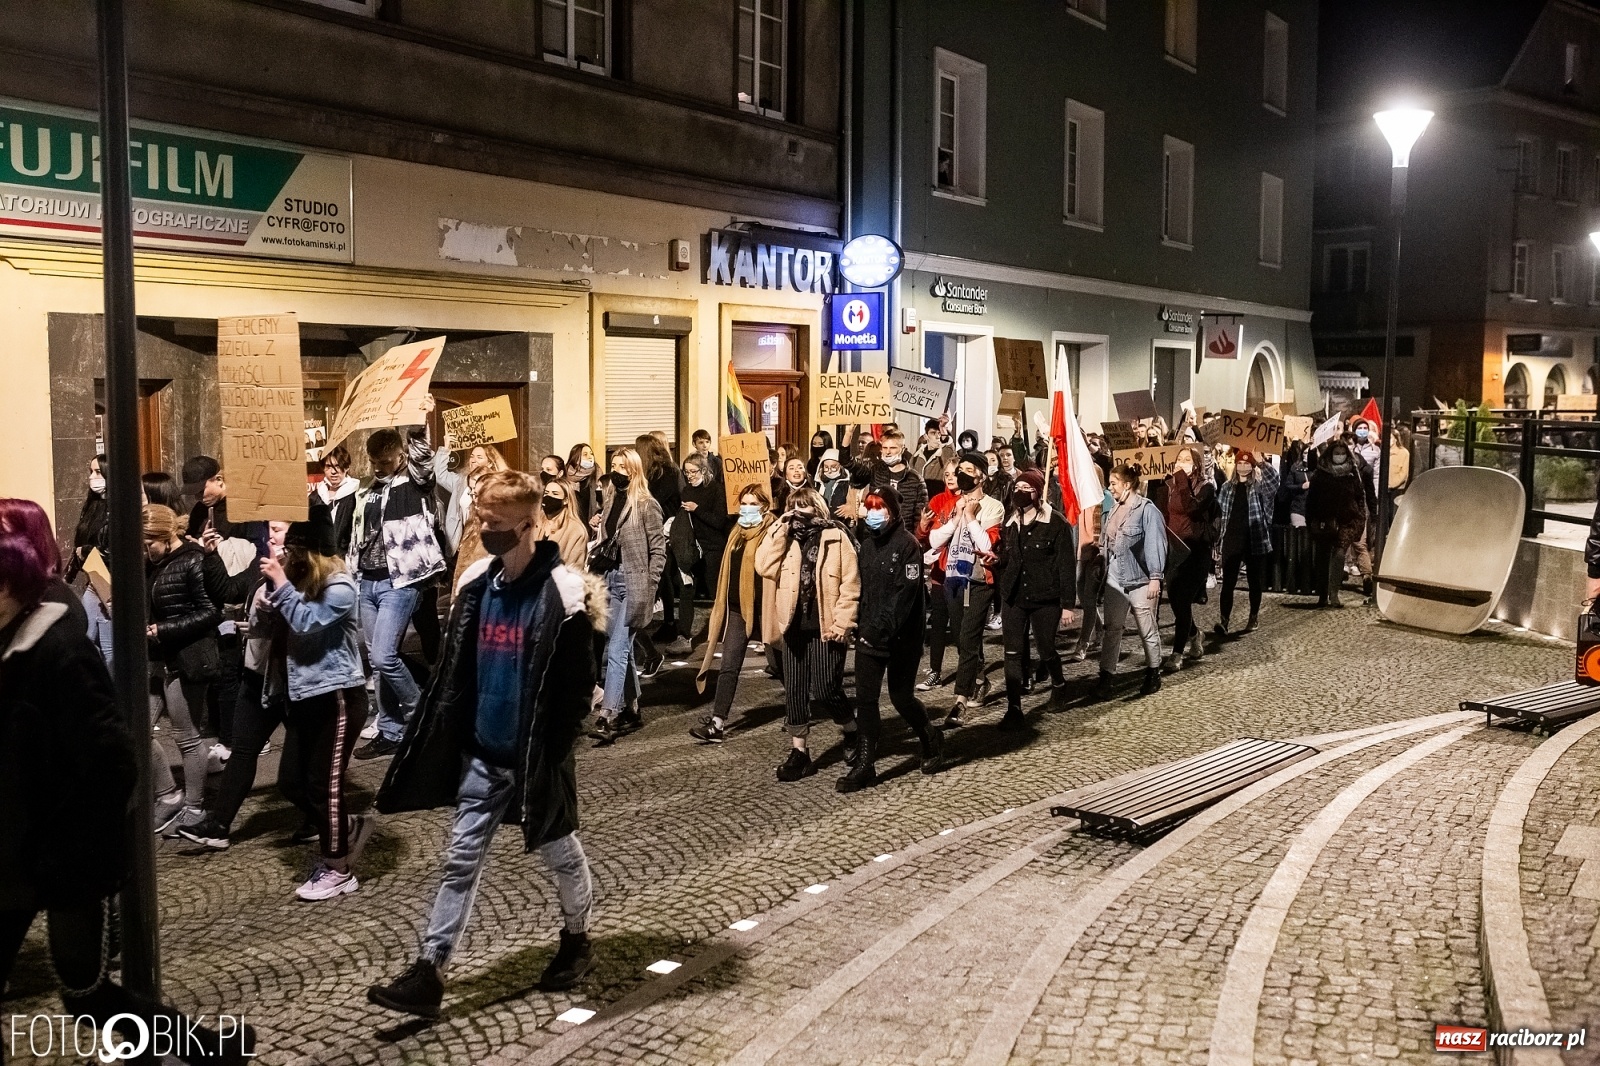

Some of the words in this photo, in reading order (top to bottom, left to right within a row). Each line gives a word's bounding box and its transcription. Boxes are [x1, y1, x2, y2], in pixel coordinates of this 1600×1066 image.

[284, 198, 338, 217] STUDIO
[266, 215, 346, 235] CYFR@FOTO
[261, 235, 346, 252] www.fotokaminski.pl
[710, 231, 834, 295] KANTOR
[946, 282, 989, 301] Santander
[945, 300, 975, 313] Consumer
[974, 303, 988, 315] Bank
[1168, 310, 1193, 322] Santander
[235, 318, 280, 335] CHCEMY
[219, 340, 251, 357] DZIECI
[834, 333, 877, 346] Monetia
[820, 374, 854, 389] REAL
[856, 375, 882, 389] MEN
[892, 380, 904, 388] OD
[908, 384, 940, 399] NASZYCH
[277, 390, 297, 407] NIE
[833, 390, 866, 404] ARE
[892, 389, 936, 411] KOBIET!
[234, 411, 280, 430] GWAŁTU
[1256, 421, 1284, 445] OFF
[232, 434, 299, 461] TERRORU
